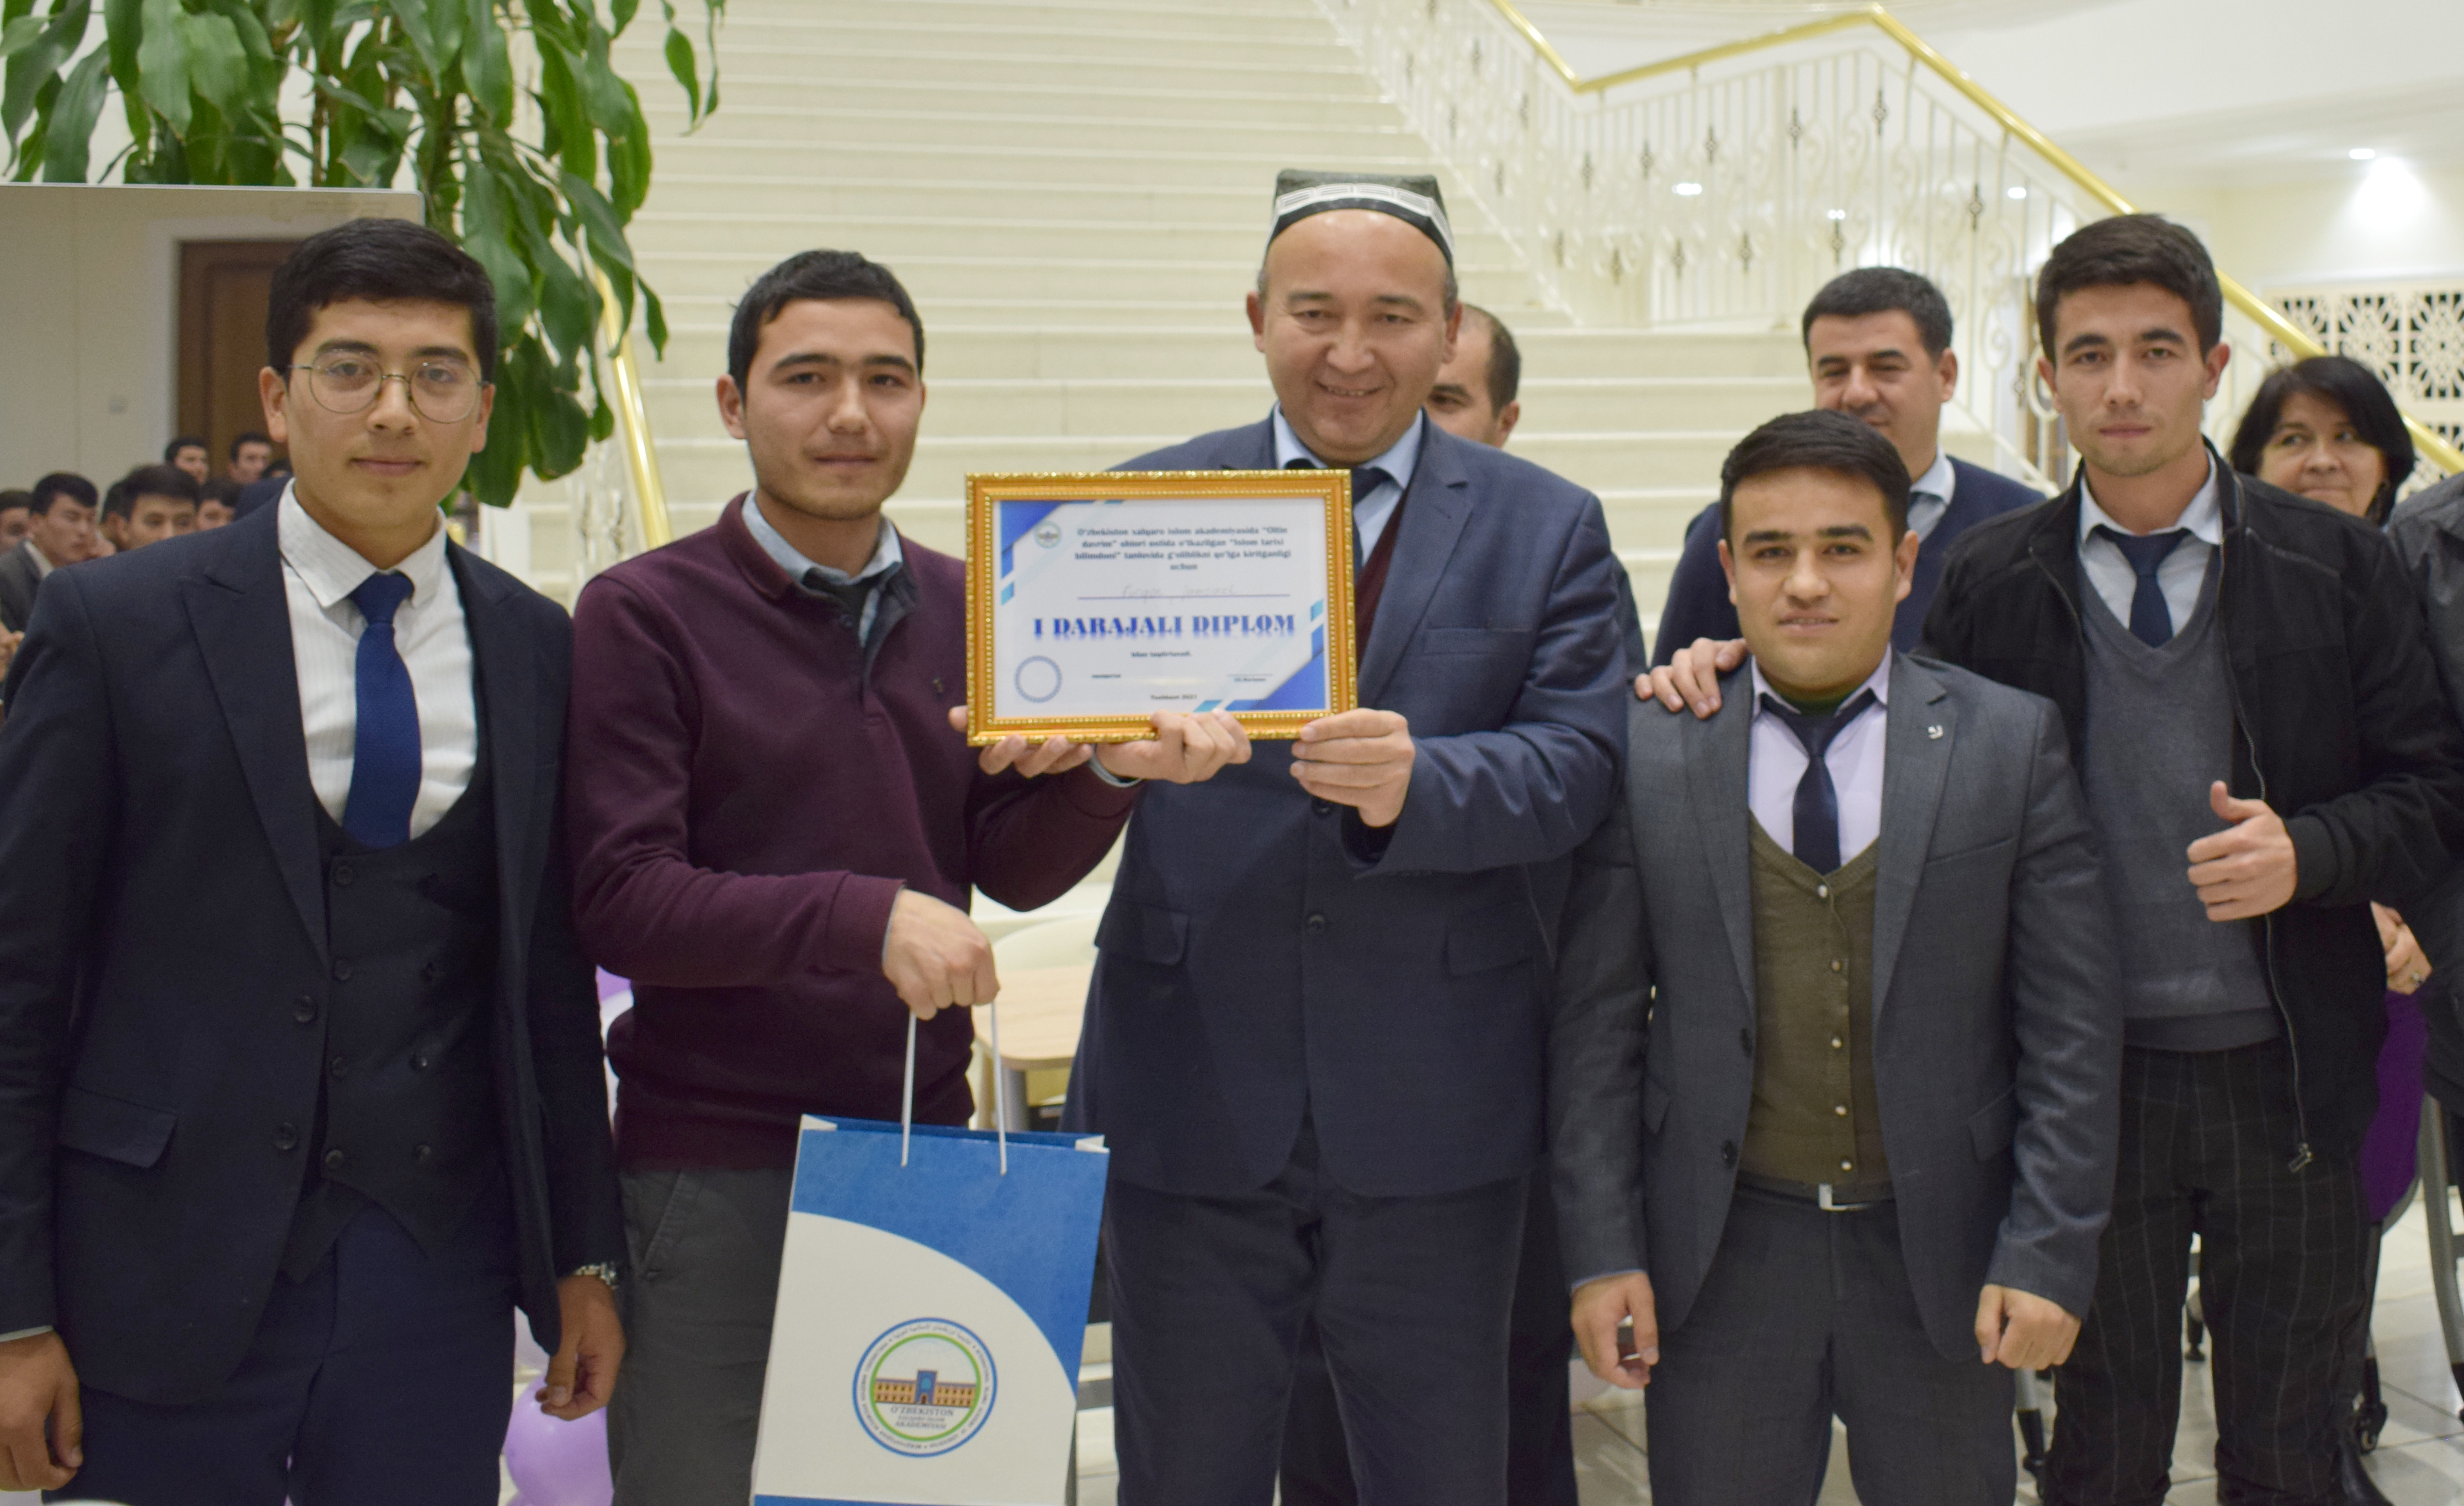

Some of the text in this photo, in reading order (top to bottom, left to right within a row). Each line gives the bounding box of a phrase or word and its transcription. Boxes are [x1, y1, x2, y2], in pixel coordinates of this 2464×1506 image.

[1034, 614, 1295, 635] I DARAJALI DIPLOM
